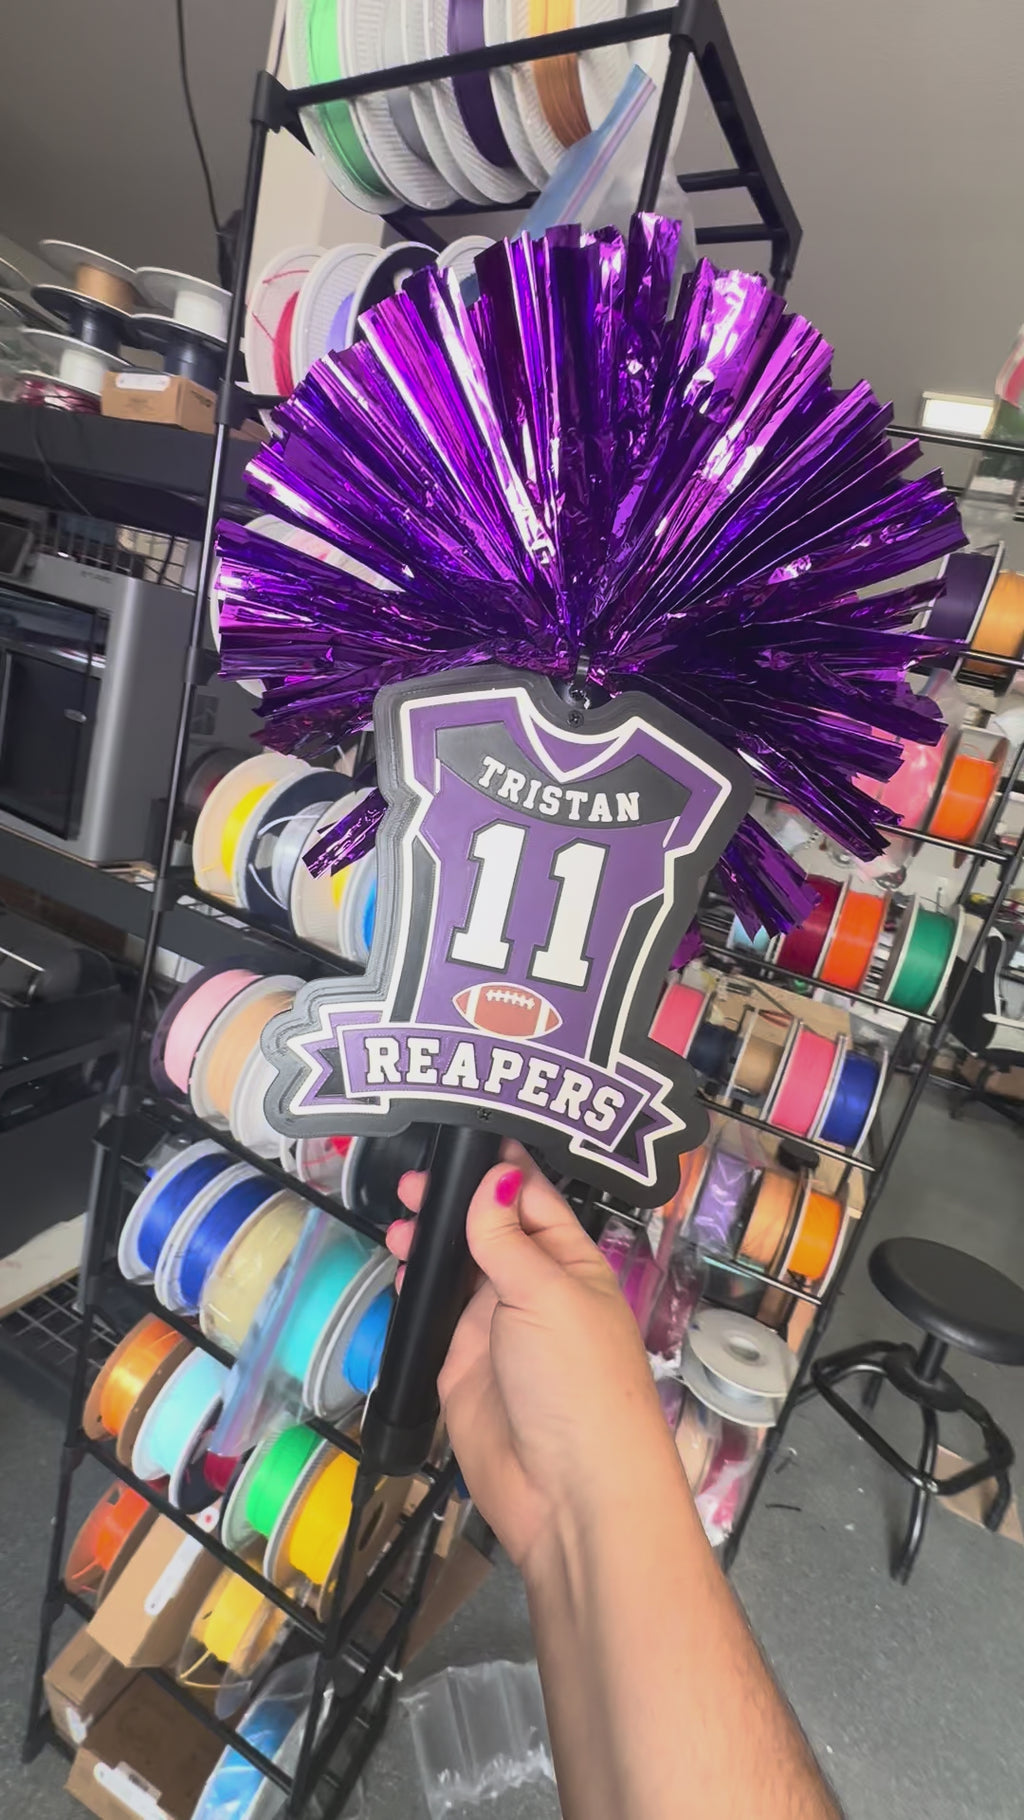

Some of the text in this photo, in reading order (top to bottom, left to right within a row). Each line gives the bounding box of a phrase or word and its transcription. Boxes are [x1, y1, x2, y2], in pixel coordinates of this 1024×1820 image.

[479, 755, 641, 823] TRISTAN
[449, 822, 609, 988] 11
[363, 1036, 626, 1132] REAPERS
